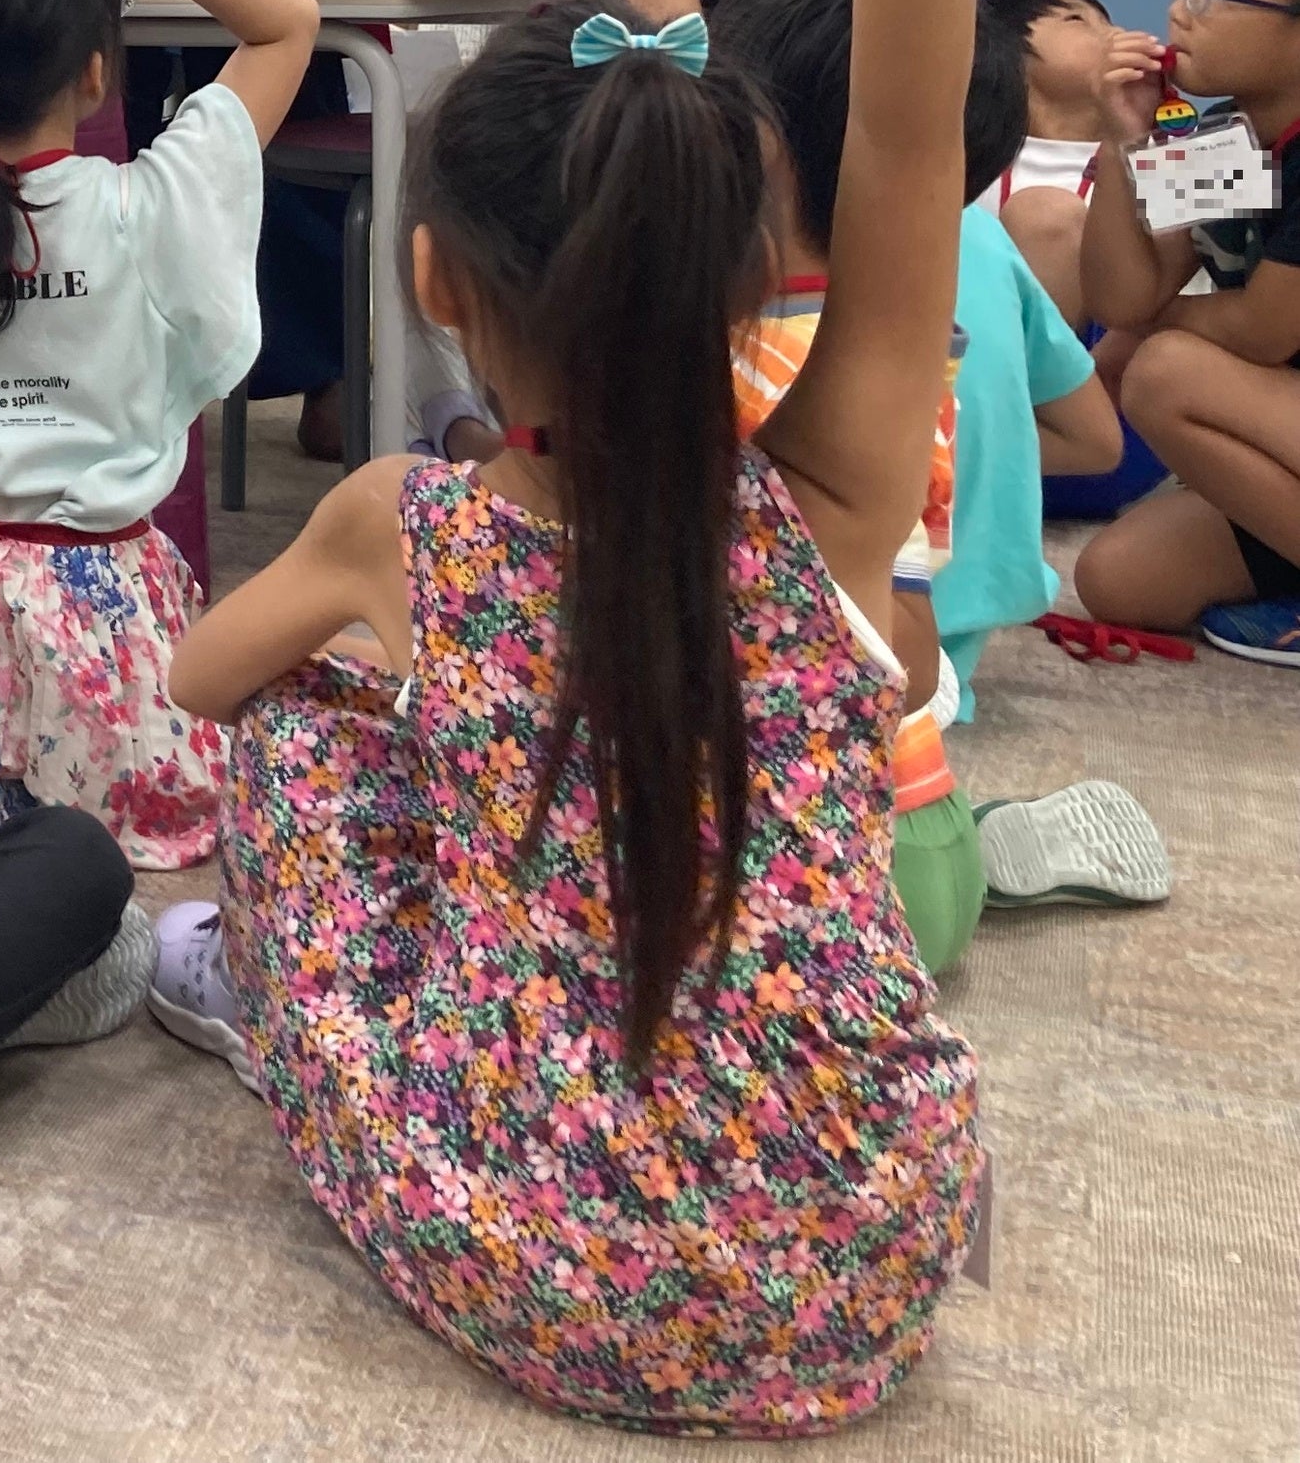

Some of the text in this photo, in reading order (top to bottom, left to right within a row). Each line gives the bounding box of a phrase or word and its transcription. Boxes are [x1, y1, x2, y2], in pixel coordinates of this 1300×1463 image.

[15, 270, 89, 301] BLE
[14, 376, 70, 390] morality
[12, 392, 48, 409] spirit.
